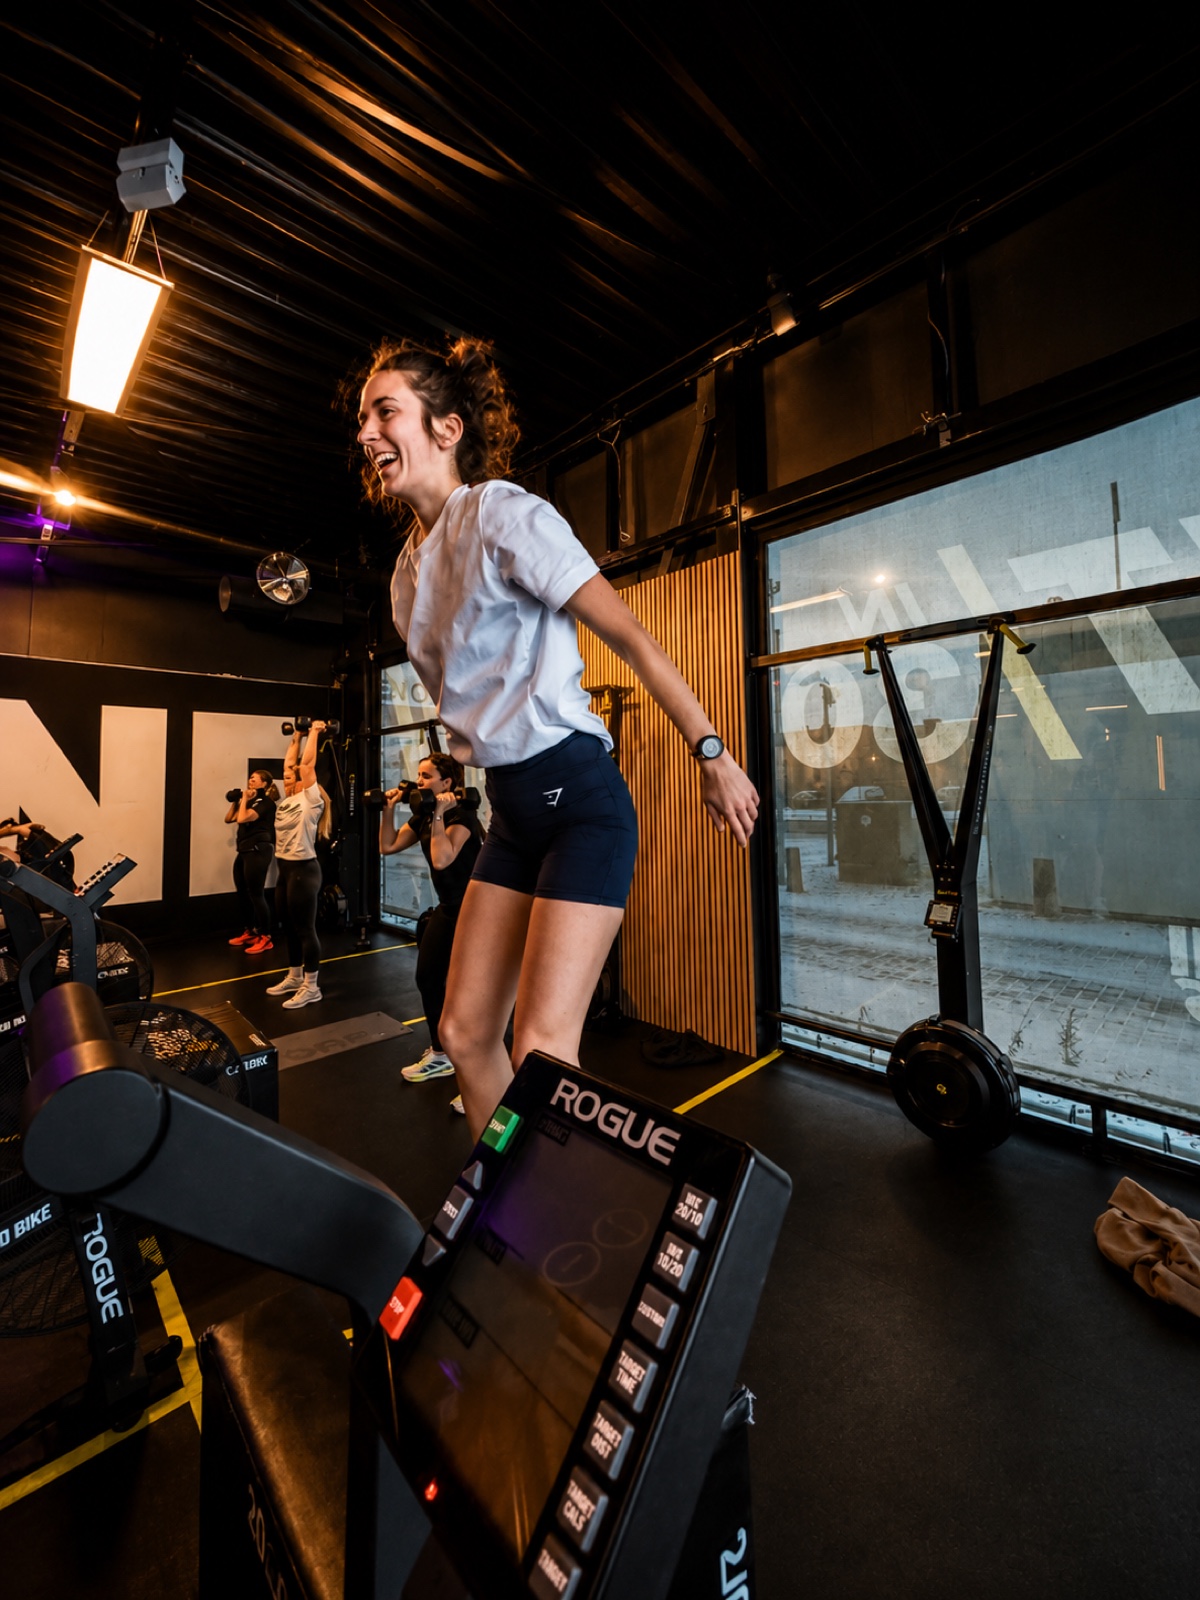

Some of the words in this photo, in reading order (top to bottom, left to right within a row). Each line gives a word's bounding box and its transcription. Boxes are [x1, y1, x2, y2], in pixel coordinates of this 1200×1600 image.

[550, 1078, 682, 1166] ROGUE
[14, 1203, 52, 1238] BIKE
[675, 1203, 704, 1226] 20/10
[657, 1252, 684, 1277] 10/20
[618, 1350, 647, 1379] TARGET
[616, 1368, 638, 1395] TIME
[593, 1412, 622, 1447] TARGET
[566, 1480, 597, 1518] TARGET
[562, 1502, 587, 1533] CALS
[537, 1548, 570, 1593] TARGET
